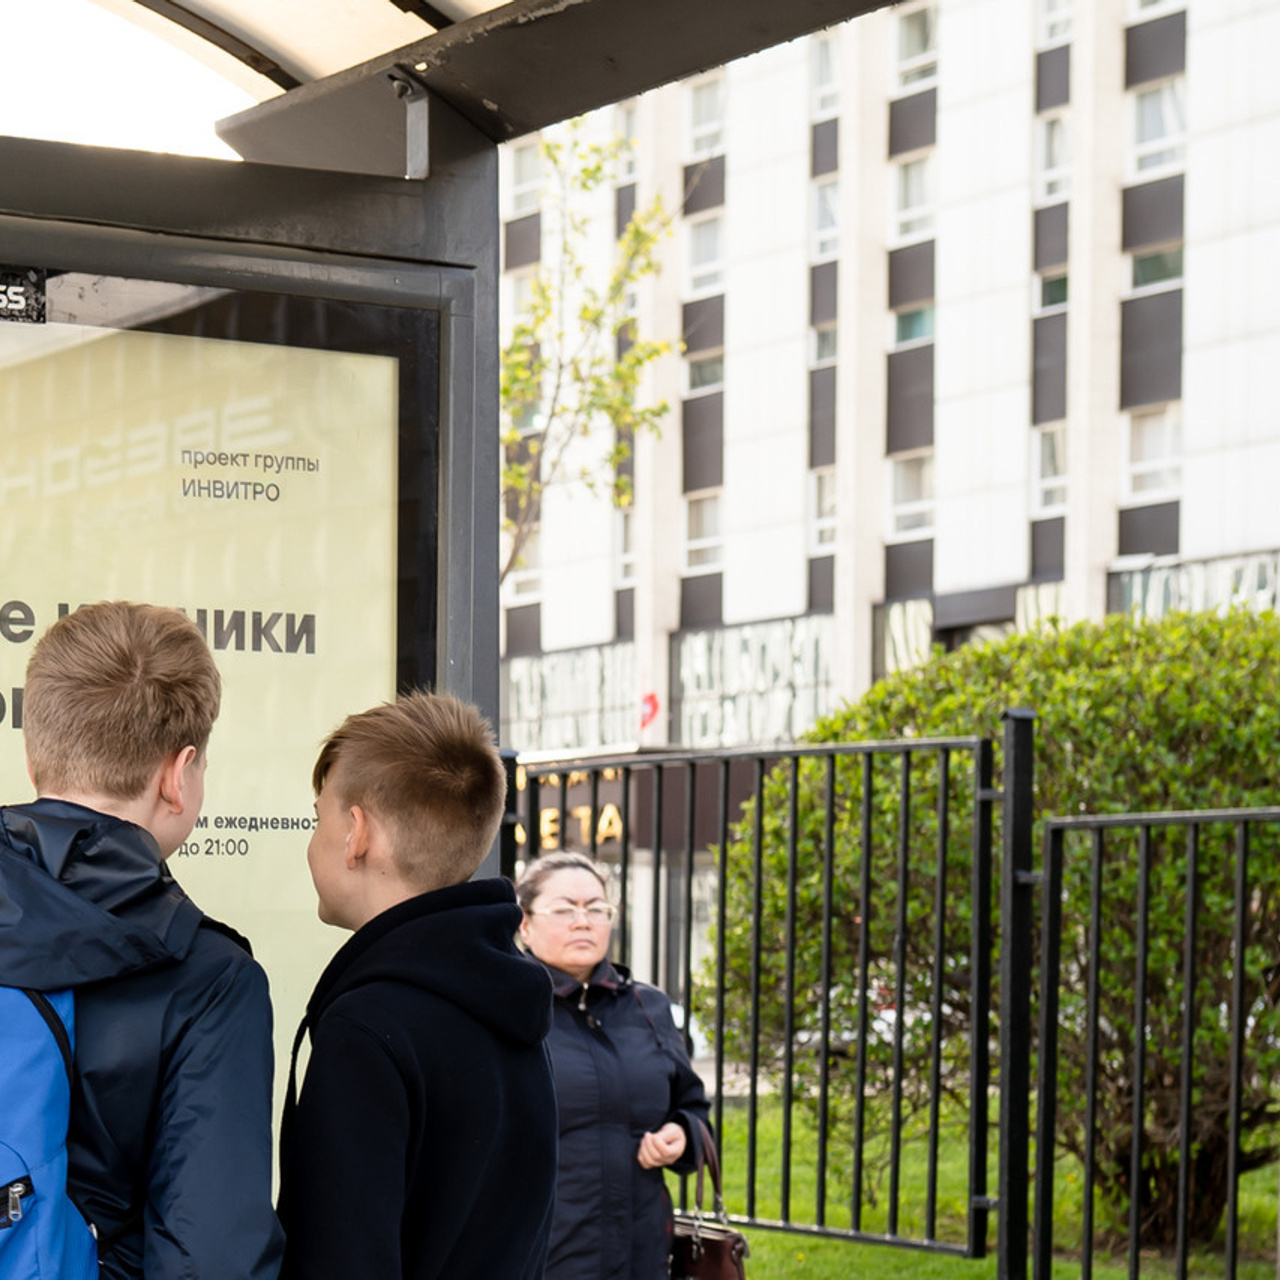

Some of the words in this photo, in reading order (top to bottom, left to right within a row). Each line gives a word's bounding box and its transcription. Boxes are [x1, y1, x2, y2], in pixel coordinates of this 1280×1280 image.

[181, 449, 250, 469] проект
[254, 453, 320, 474] группы
[182, 478, 280, 502] ИНВИТРО
[214, 815, 316, 832] ежедневно:
[178, 842, 200, 857] до
[204, 838, 249, 856] 21:00
